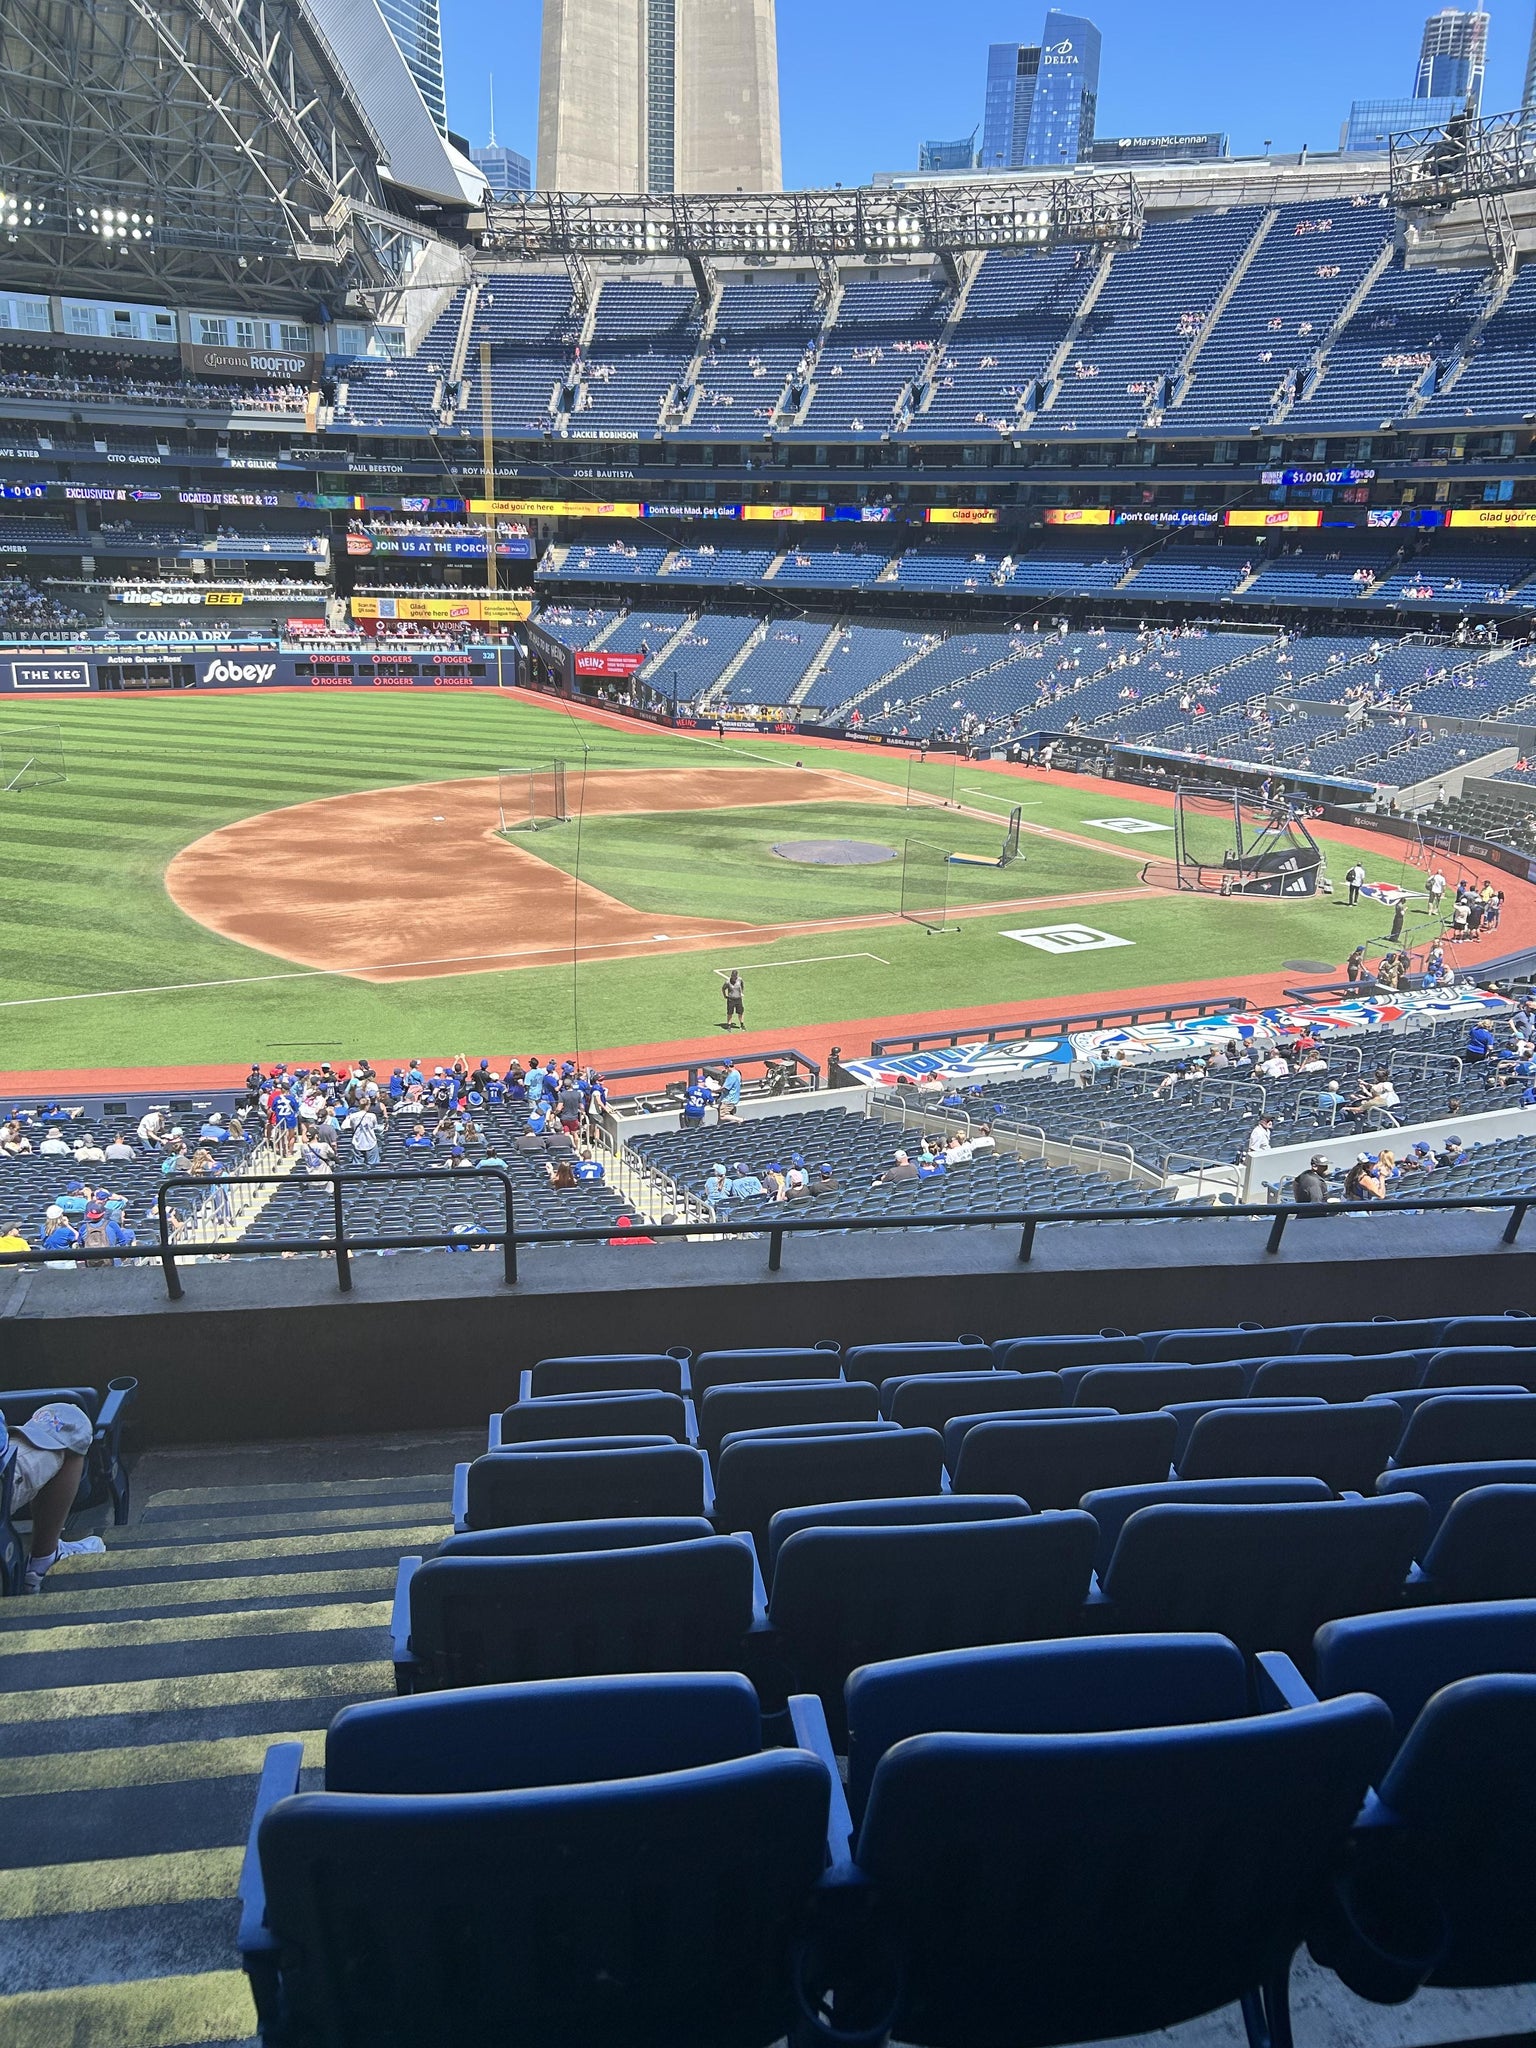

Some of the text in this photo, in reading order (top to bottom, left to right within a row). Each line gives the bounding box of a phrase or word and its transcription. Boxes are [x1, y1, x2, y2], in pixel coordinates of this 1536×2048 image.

[1044, 55, 1079, 65] DELTA
[204, 353, 306, 373] Corona ROOFTOP
[267, 371, 291, 379] PATIO
[571, 431, 639, 440] JACKIE ROBINSON
[16, 450, 40, 458] STIEB
[107, 454, 160, 464] CITO GASTON
[231, 460, 278, 469] PAT GILLICK
[348, 464, 403, 473] PAUL BEESTON
[463, 467, 518, 476] ROY HALLADAY
[573, 469, 634, 479] JOSÉ BAUTISTA
[66, 488, 126, 500] EXCLUSIVELY AT
[179, 492, 278, 506] LOCATED AT SEC. 112 & 123
[492, 502, 509, 510] Glad
[510, 503, 535, 512] you're
[649, 506, 735, 516] Don't Get Mad. Get Glad
[774, 508, 793, 517] GLAD
[952, 510, 970, 519] Glad
[1121, 512, 1218, 522] Don't Get Mad. Get Glad
[1479, 512, 1503, 521] Glad
[1266, 513, 1288, 524] GLAD
[376, 541, 399, 551] JOIN
[402, 542, 415, 551] US
[418, 543, 431, 552] AT
[434, 543, 452, 552] THE
[123, 590, 200, 605] theScore
[207, 594, 242, 603] BET
[451, 607, 469, 616] GLAD
[386, 621, 418, 631] ROGERS
[2, 631, 88, 640] BLEACHERS
[137, 631, 231, 641] CANADA DRY
[107, 655, 133, 663] Active
[320, 655, 351, 663] ROGERS
[381, 655, 412, 663] ROGERS
[442, 655, 473, 664] ROGERS
[482, 652, 495, 660] 328
[578, 656, 604, 670] HEINZ
[21, 670, 80, 679] THE KEG
[203, 659, 276, 683] Sobeys
[676, 719, 697, 728] HEINZ
[774, 724, 796, 733] HEINZ
[1361, 819, 1378, 827] clover
[1020, 930, 1106, 946] TD
[689, 1096, 704, 1107] 30
